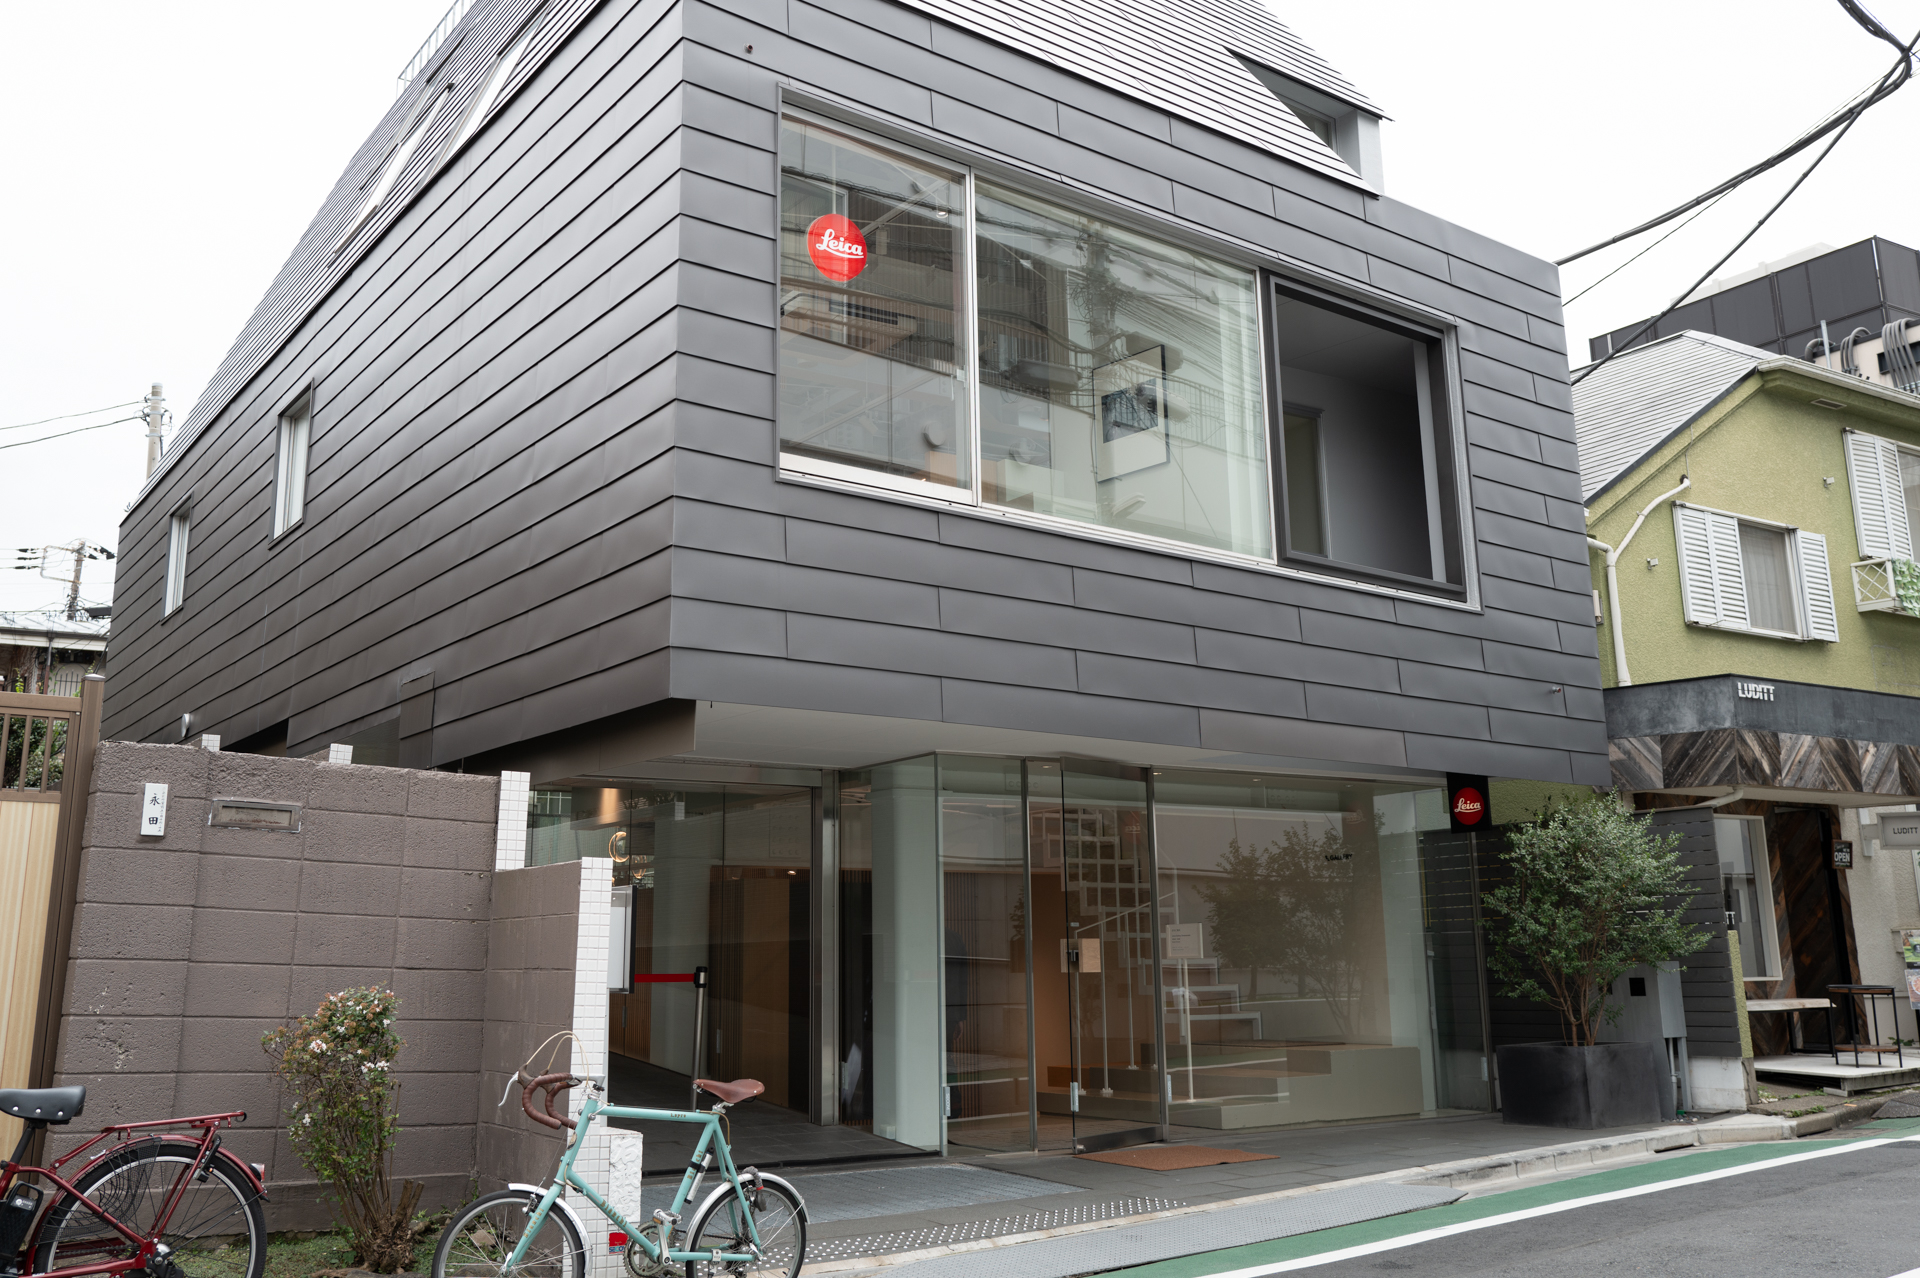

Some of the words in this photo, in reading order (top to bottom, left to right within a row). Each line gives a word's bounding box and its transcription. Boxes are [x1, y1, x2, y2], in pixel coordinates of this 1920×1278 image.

[816, 229, 864, 258] Leica
[1737, 682, 1775, 701] LUDITT
[149, 793, 160, 825] 永田
[1454, 798, 1481, 813] Leica
[1893, 827, 1918, 835] LUDITT
[1834, 852, 1850, 862] OPEN
